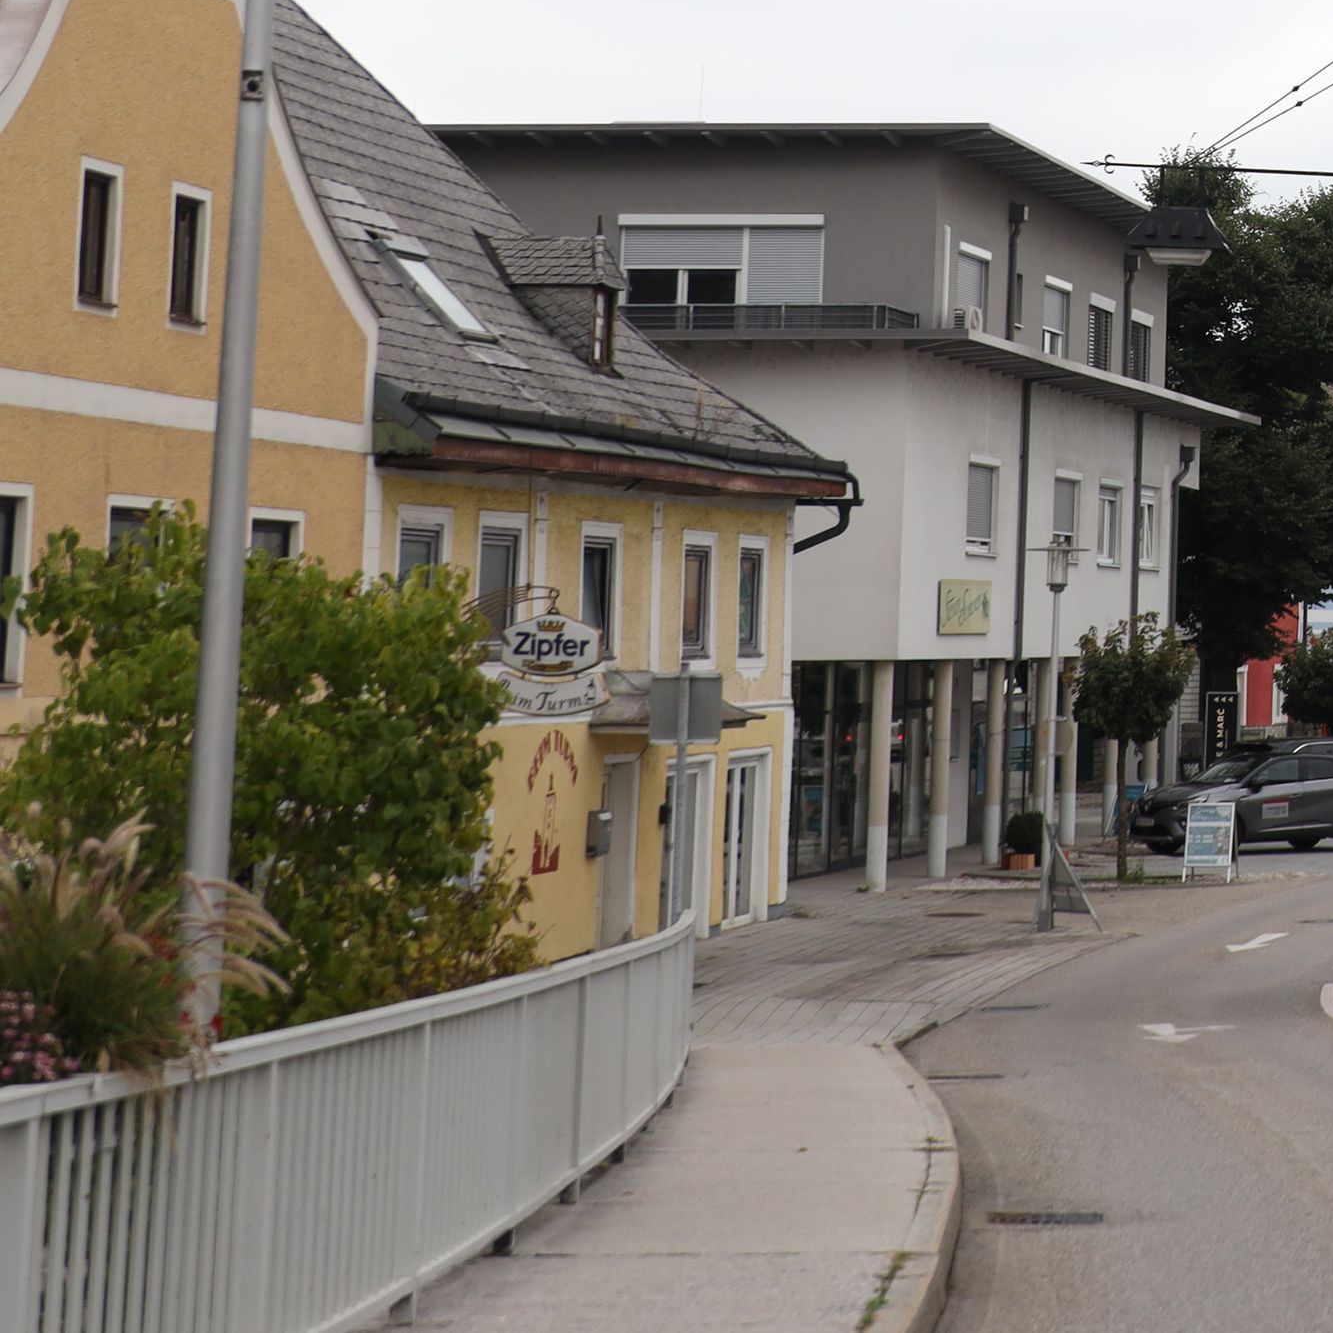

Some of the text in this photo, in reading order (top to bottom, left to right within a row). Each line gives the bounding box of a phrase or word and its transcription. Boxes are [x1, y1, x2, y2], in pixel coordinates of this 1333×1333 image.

[512, 632, 590, 661] Zipfer
[536, 689, 582, 711] Turm
[1216, 708, 1225, 738] MARC
